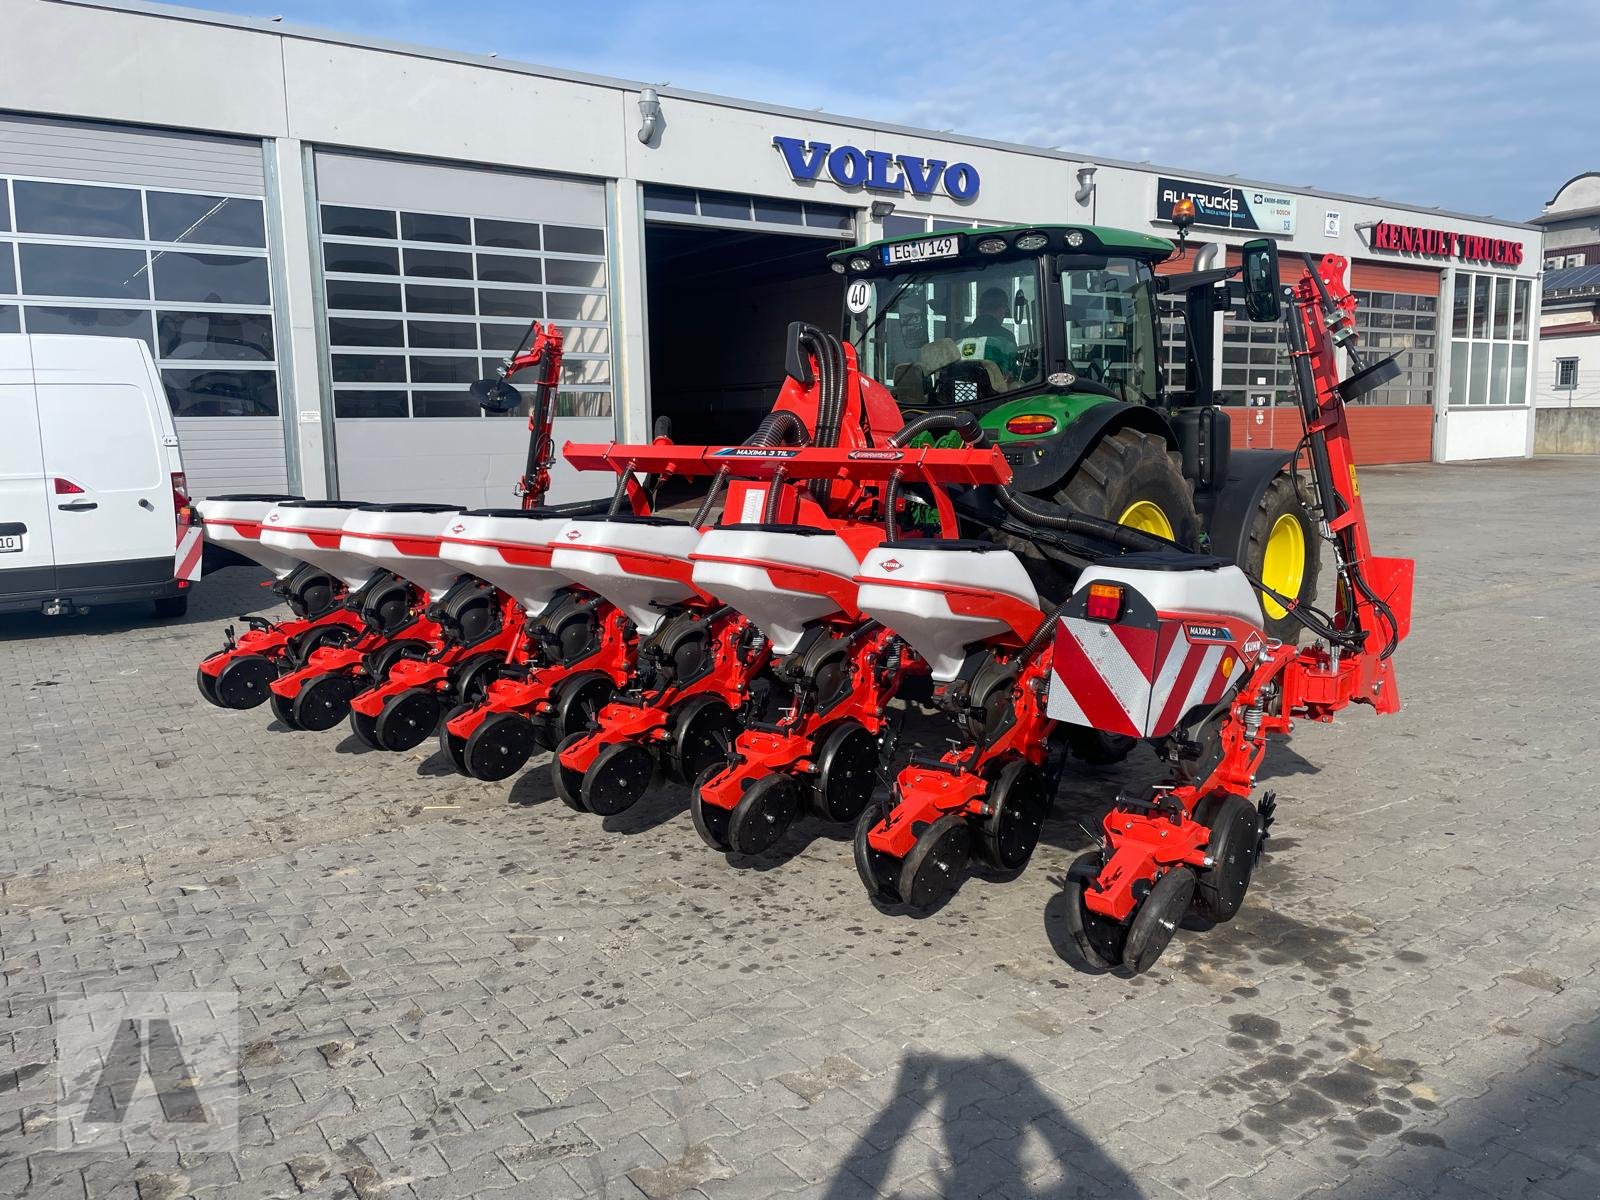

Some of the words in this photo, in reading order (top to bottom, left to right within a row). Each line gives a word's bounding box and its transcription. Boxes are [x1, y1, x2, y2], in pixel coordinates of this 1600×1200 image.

[771, 135, 981, 200] VOLVO
[894, 244, 911, 260] EG
[918, 242, 926, 257] V
[928, 238, 952, 256] 149
[1376, 223, 1460, 257] RENAULT
[1463, 234, 1524, 266] TRUCKS
[851, 284, 866, 307] 40
[1190, 626, 1212, 636] MAXIMA
[1211, 628, 1217, 637] 3
[1244, 640, 1261, 653] KUHN
